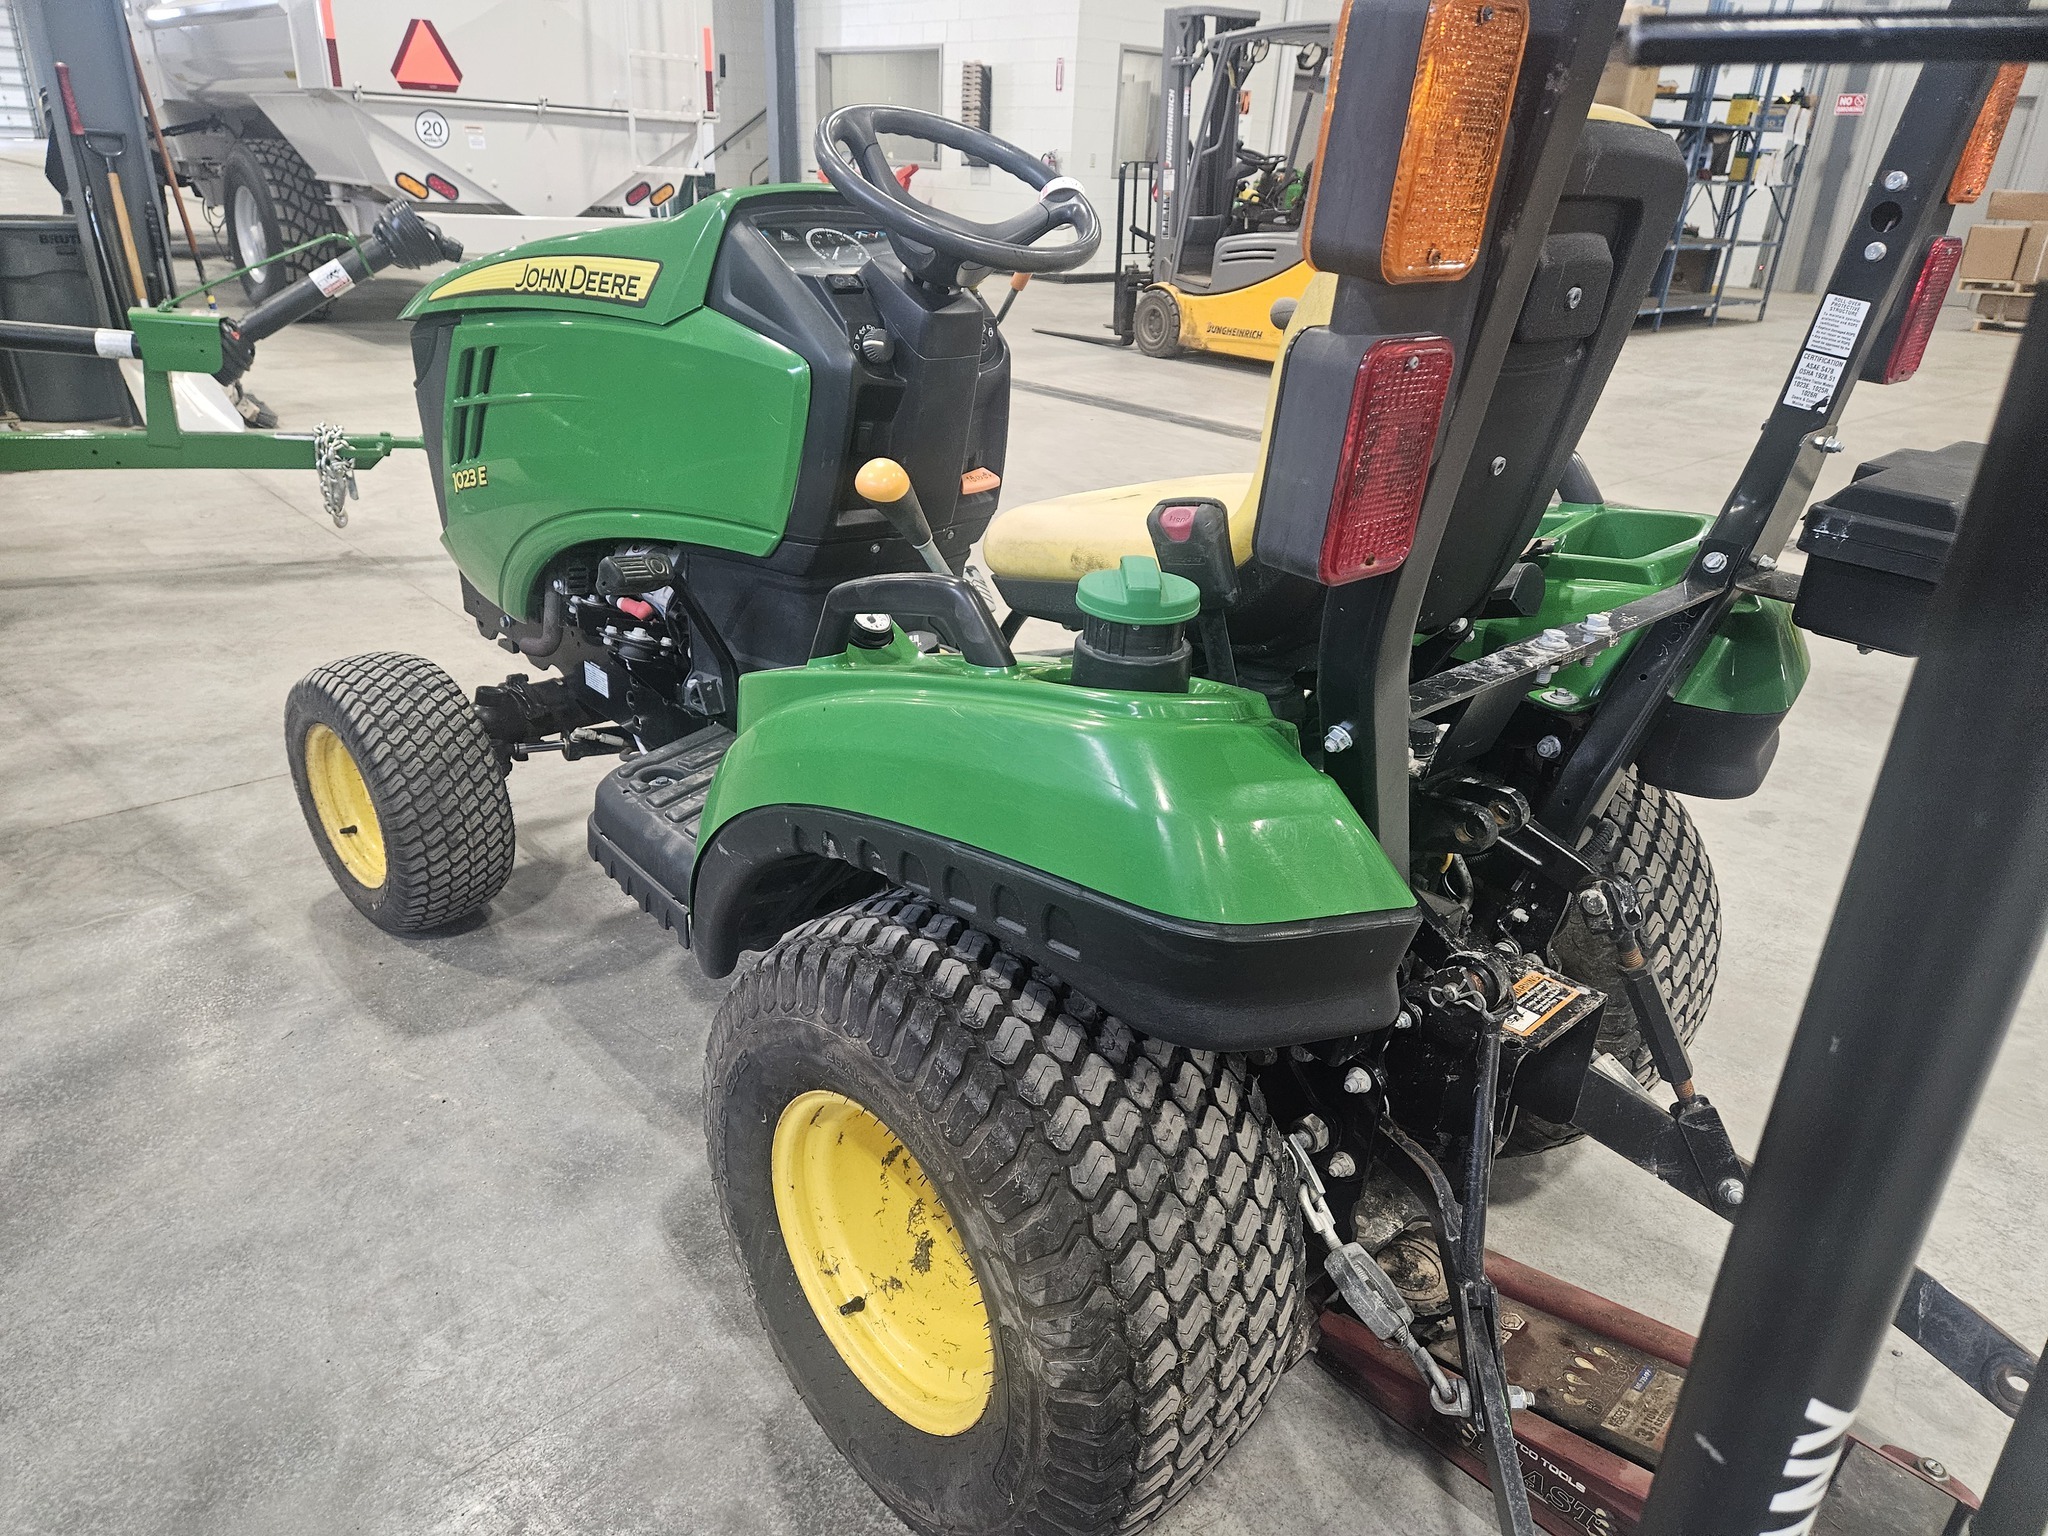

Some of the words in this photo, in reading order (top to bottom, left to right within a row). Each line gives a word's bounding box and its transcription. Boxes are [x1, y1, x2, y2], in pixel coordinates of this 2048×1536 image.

[1840, 96, 1853, 106] NO
[422, 120, 443, 137] 20
[515, 263, 567, 290] JOHN
[569, 264, 641, 298] DEERE
[1207, 324, 1263, 339] JUNGHEINRICH
[1803, 353, 1843, 367] CERTIFICATION
[1806, 362, 1819, 370] ASAE
[1541, 1457, 1586, 1494] TOOLS
